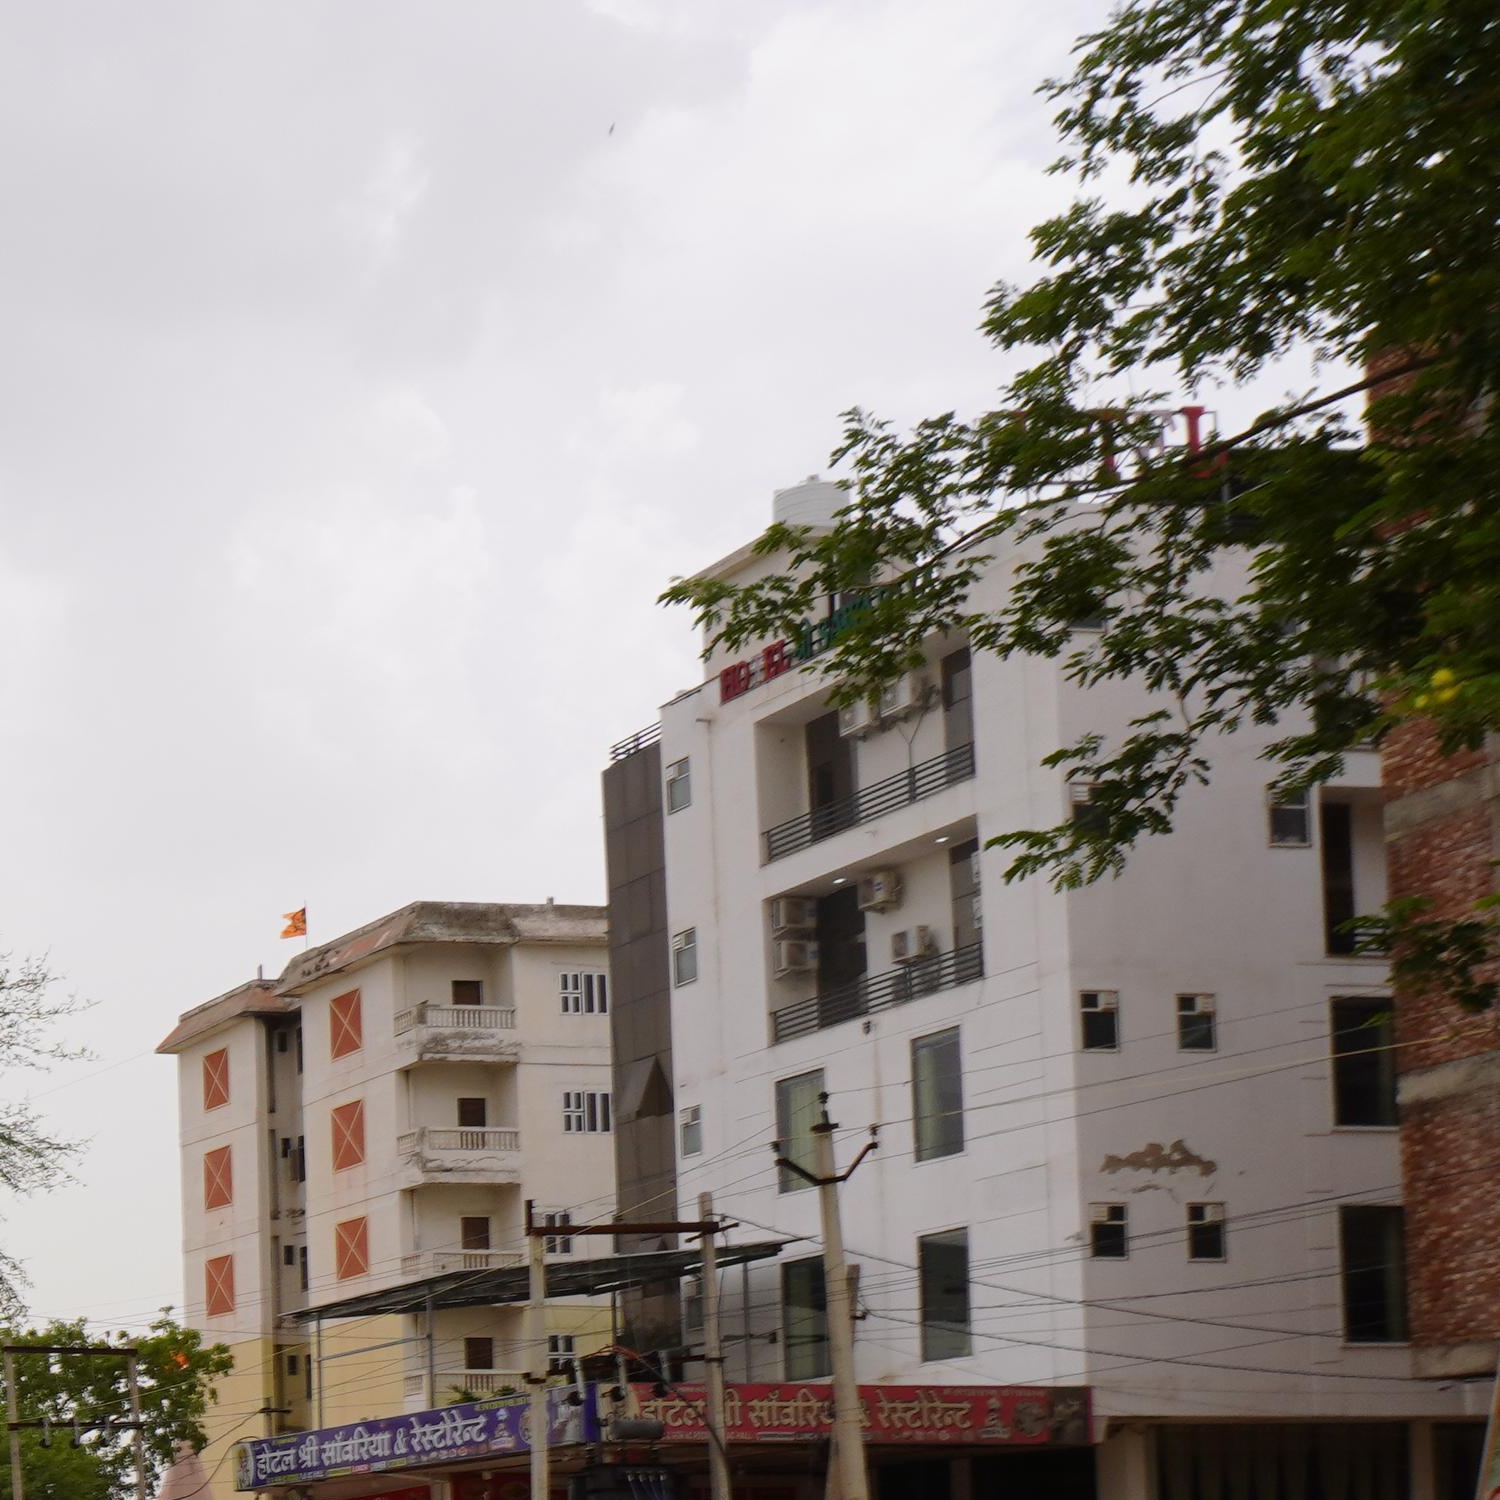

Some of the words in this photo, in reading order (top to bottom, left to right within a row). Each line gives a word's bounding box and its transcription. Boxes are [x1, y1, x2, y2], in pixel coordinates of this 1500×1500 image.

[256, 1443, 297, 1479] होटल
[298, 1434, 320, 1468] श्री
[394, 1427, 408, 1455] &
